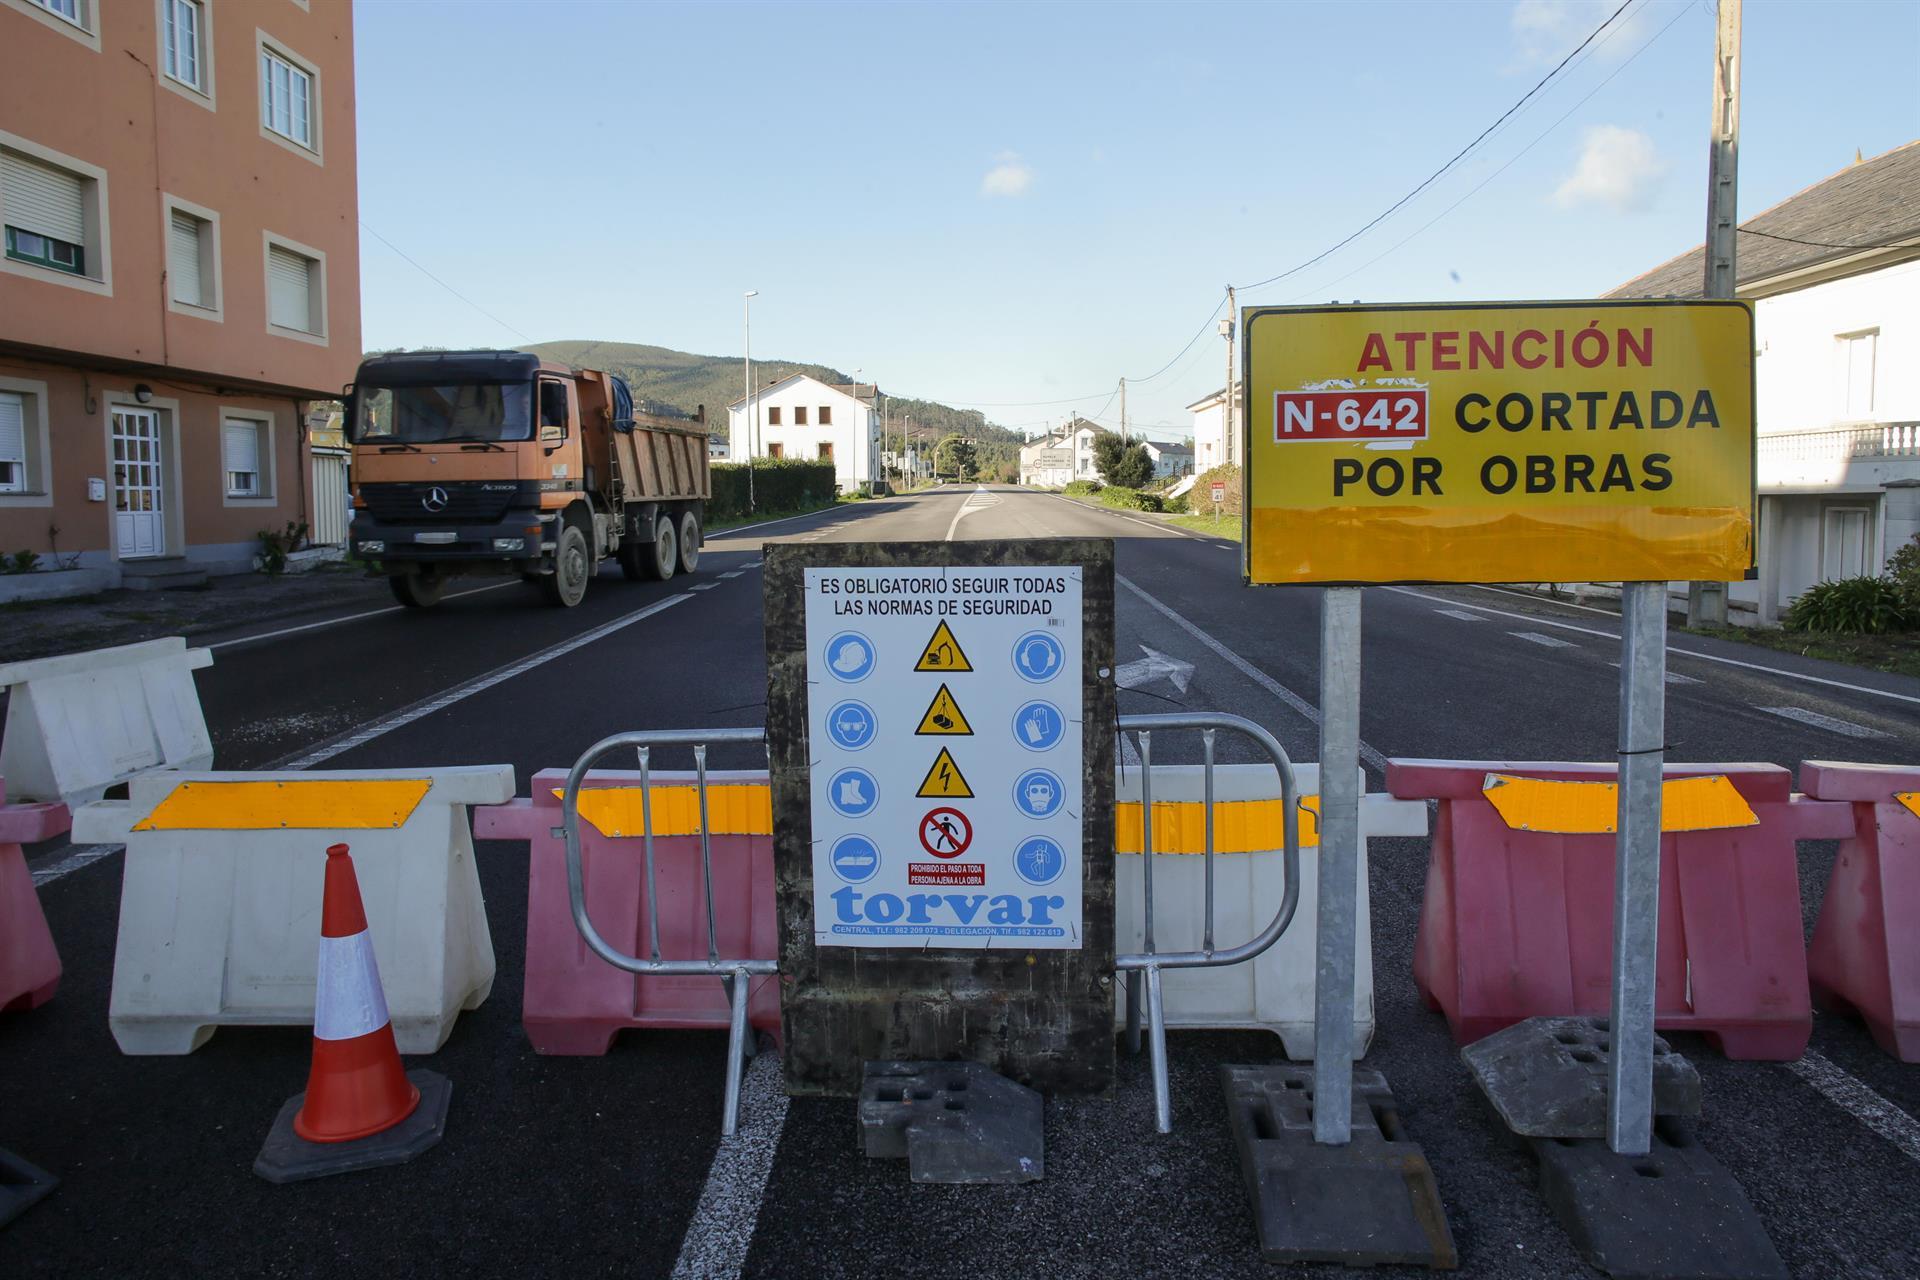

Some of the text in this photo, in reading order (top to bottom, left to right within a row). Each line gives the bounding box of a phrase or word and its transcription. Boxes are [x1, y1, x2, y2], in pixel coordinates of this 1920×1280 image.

[1357, 320, 1653, 373] ATENCIÓN
[1283, 389, 1720, 433] N-642 CORTADA
[1333, 453, 1673, 497] POR OBRAS
[821, 577, 1066, 594] ES OBLIGATORIO SEGUIR TODAS
[834, 599, 1052, 615] LAS NORMAS DE SEGURIDAD
[910, 864, 940, 873] PROHIBIDO
[948, 865, 962, 873] PASO
[830, 886, 1065, 925] torvar
